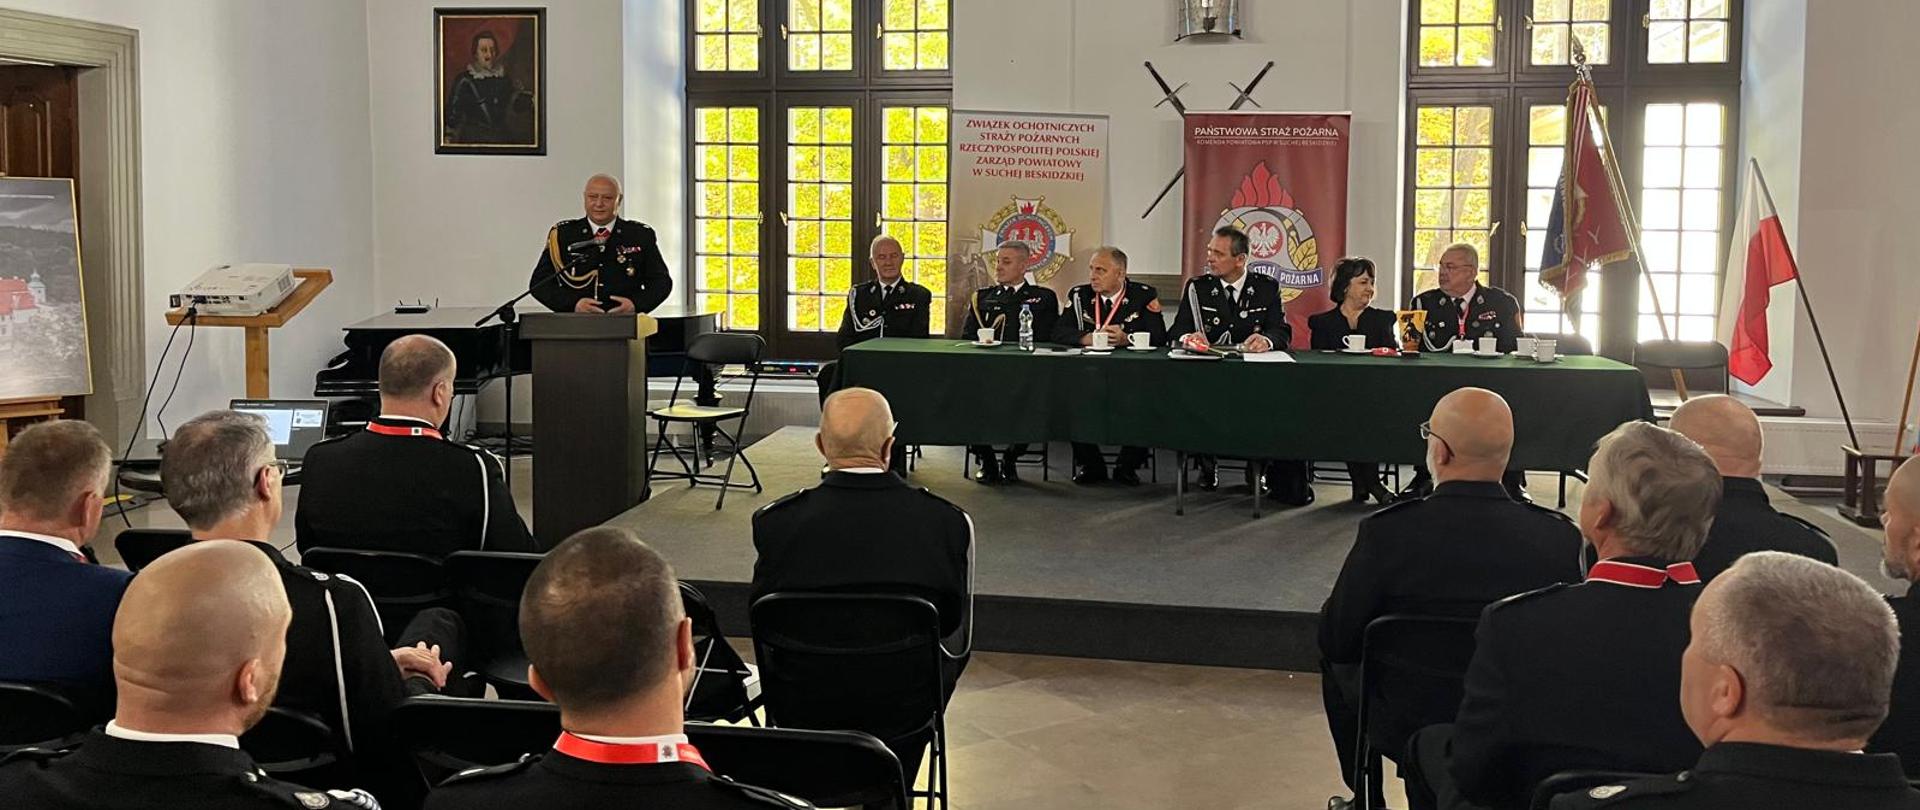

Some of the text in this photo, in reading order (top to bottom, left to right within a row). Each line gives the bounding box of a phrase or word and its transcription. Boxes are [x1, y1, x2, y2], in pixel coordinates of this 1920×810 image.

[966, 120, 1095, 132] ZWIĄZEK OCHOTNICZYCH
[1194, 125, 1339, 137] PAŃSTWOWA STRAŻ POŻARNA
[980, 130, 1079, 144] STRAŻY POŻARNYCH
[960, 144, 1100, 158] RZECZYPOSPOLITEJ POLSKIEJ
[976, 156, 1082, 168] ZARZĄD POWIATOWY
[972, 168, 1084, 182] W SUCHEJ BESKIDZKIEJ
[1280, 271, 1320, 285] POŻARNA
